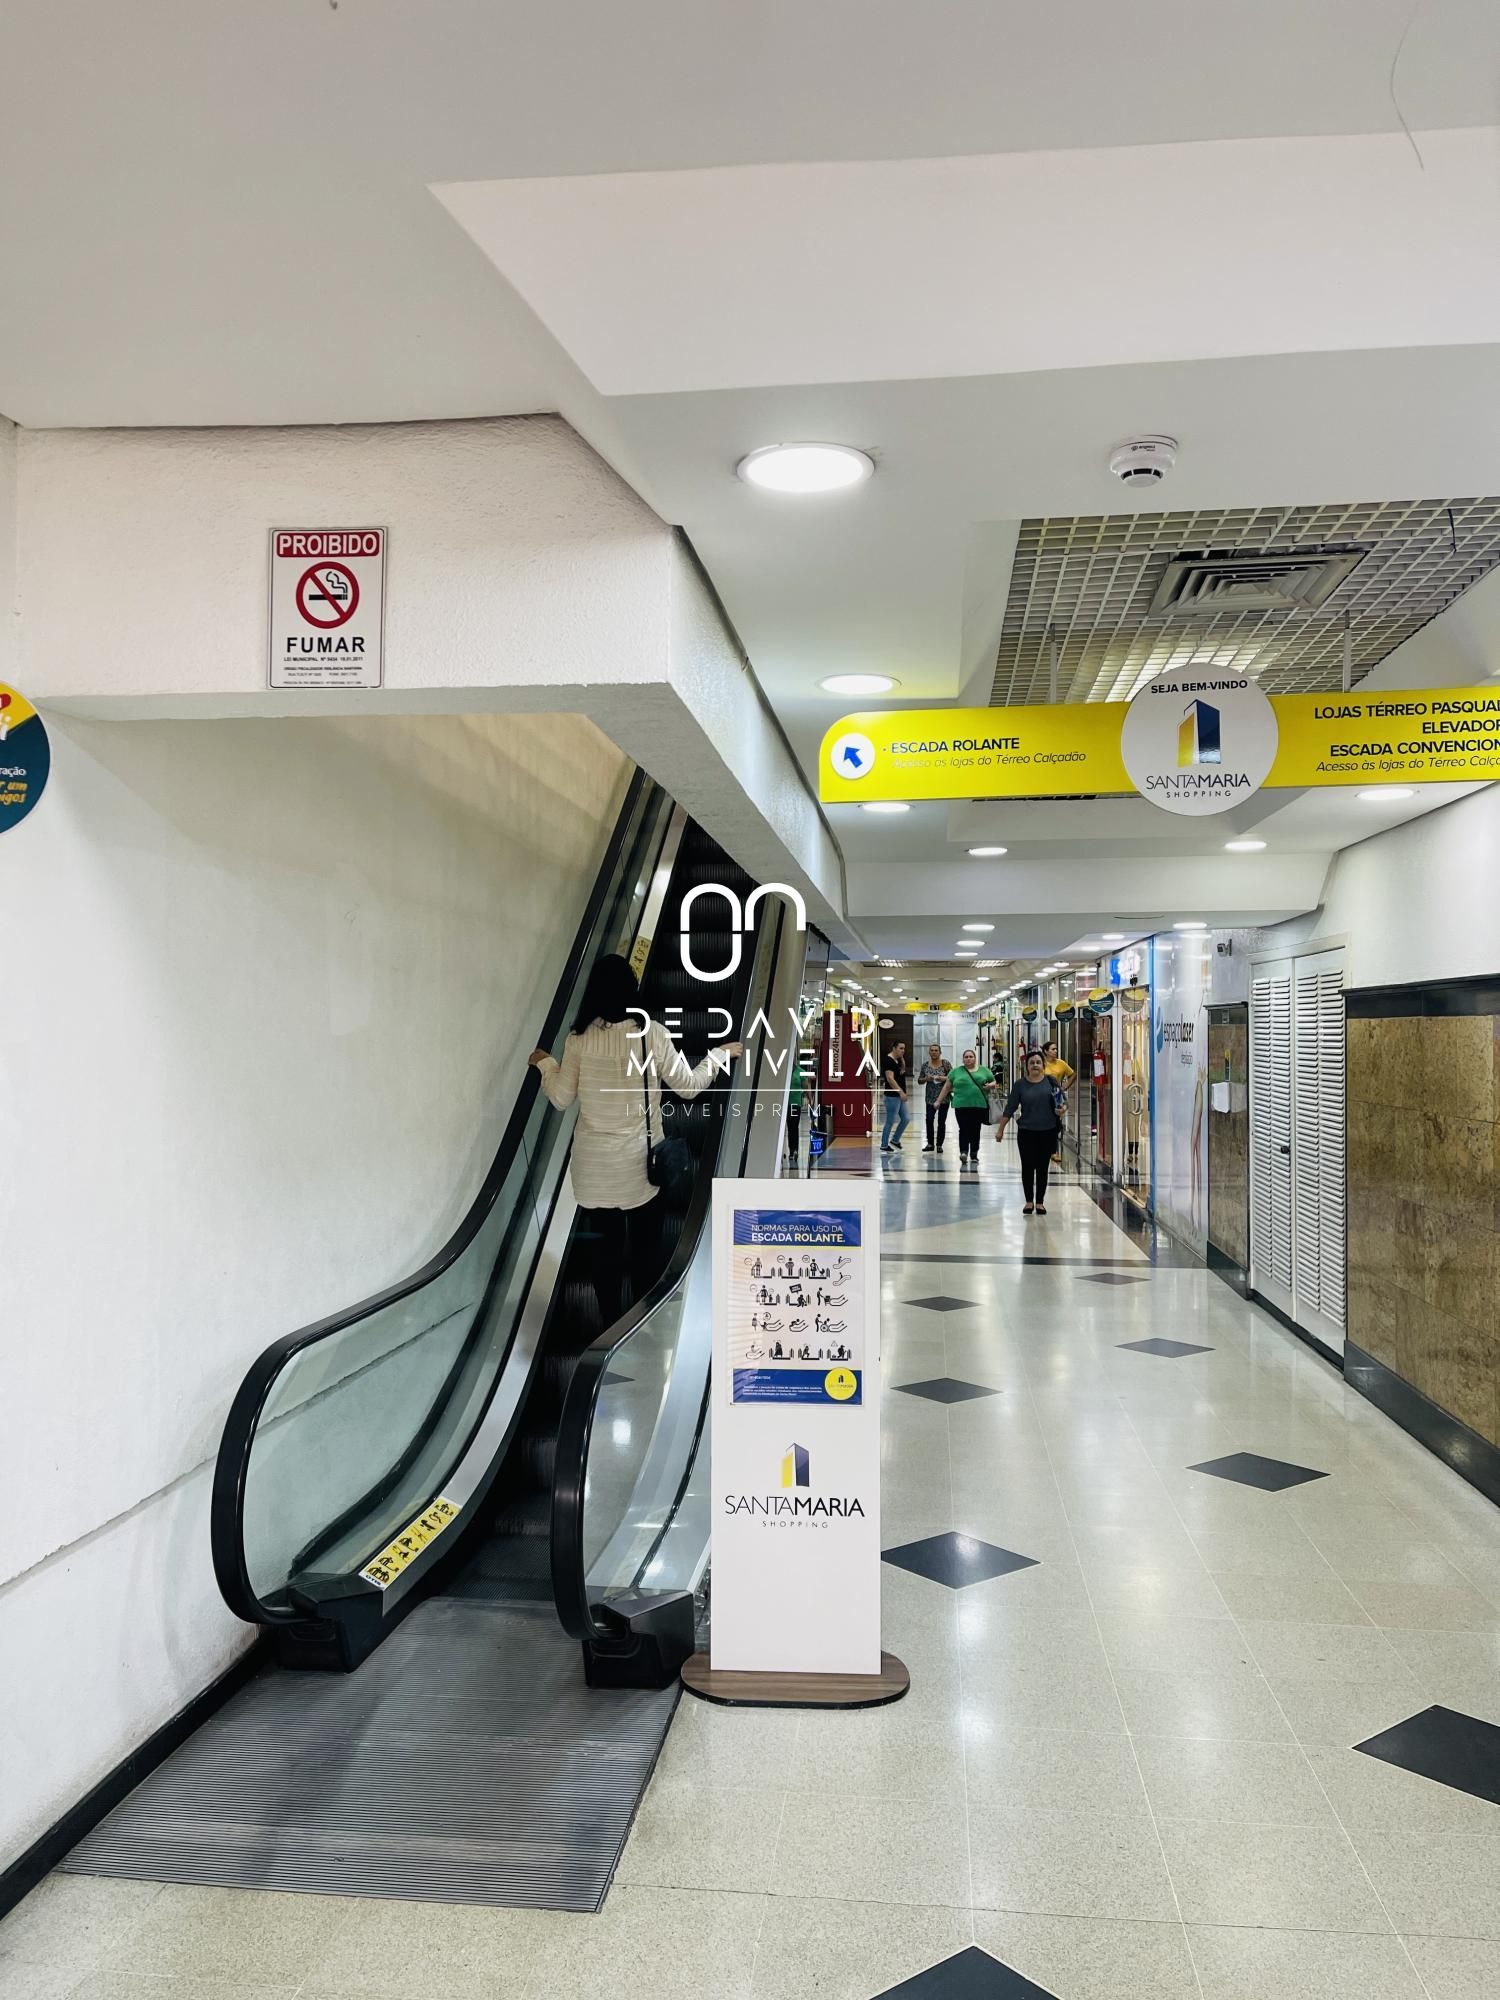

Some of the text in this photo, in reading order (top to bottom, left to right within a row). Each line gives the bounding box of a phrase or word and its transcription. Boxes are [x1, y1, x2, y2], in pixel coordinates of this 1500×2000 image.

[279, 534, 377, 555] PROIBIDO
[287, 637, 365, 653] FUMAR
[1151, 679, 1248, 694] SEJA BEM-VINDO
[1314, 705, 1362, 719] LOJAS
[1366, 701, 1427, 718] TÉRREO
[891, 737, 1020, 754] ESCADA ROLANTE
[1330, 743, 1393, 757] ESCADA
[949, 755, 975, 770] lojas
[977, 753, 992, 765] do
[1034, 750, 1086, 765] Calçadão
[1316, 760, 1358, 772] Acesso
[1378, 758, 1405, 773] lojas
[1408, 758, 1424, 769] do
[1146, 773, 1251, 790] SANTAMARIA
[1166, 790, 1232, 799] SHOPPING
[751, 1224, 843, 1233] NORMAS PARA USO DA
[751, 1233, 793, 1242] ESCADA
[724, 1494, 865, 1518] SANTAMARIA
[762, 1520, 829, 1529] SHOPPING
